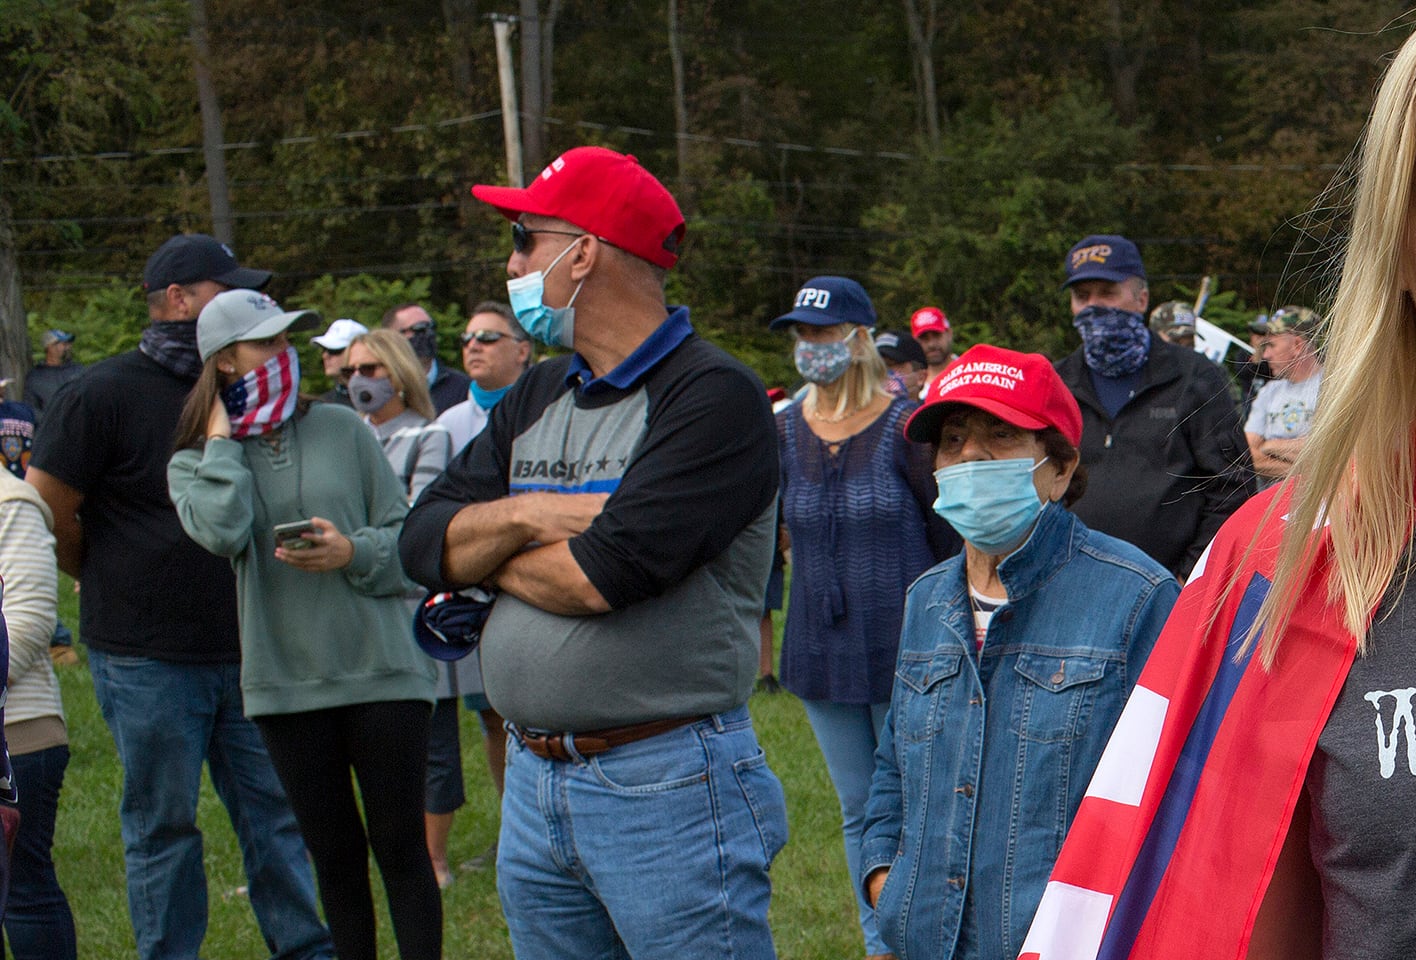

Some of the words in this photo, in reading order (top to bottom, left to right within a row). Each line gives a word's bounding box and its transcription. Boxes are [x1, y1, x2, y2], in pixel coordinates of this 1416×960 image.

[963, 361, 1025, 381] AMERICA
[939, 374, 973, 397] GREAT
[971, 374, 1016, 390] AGAIN
